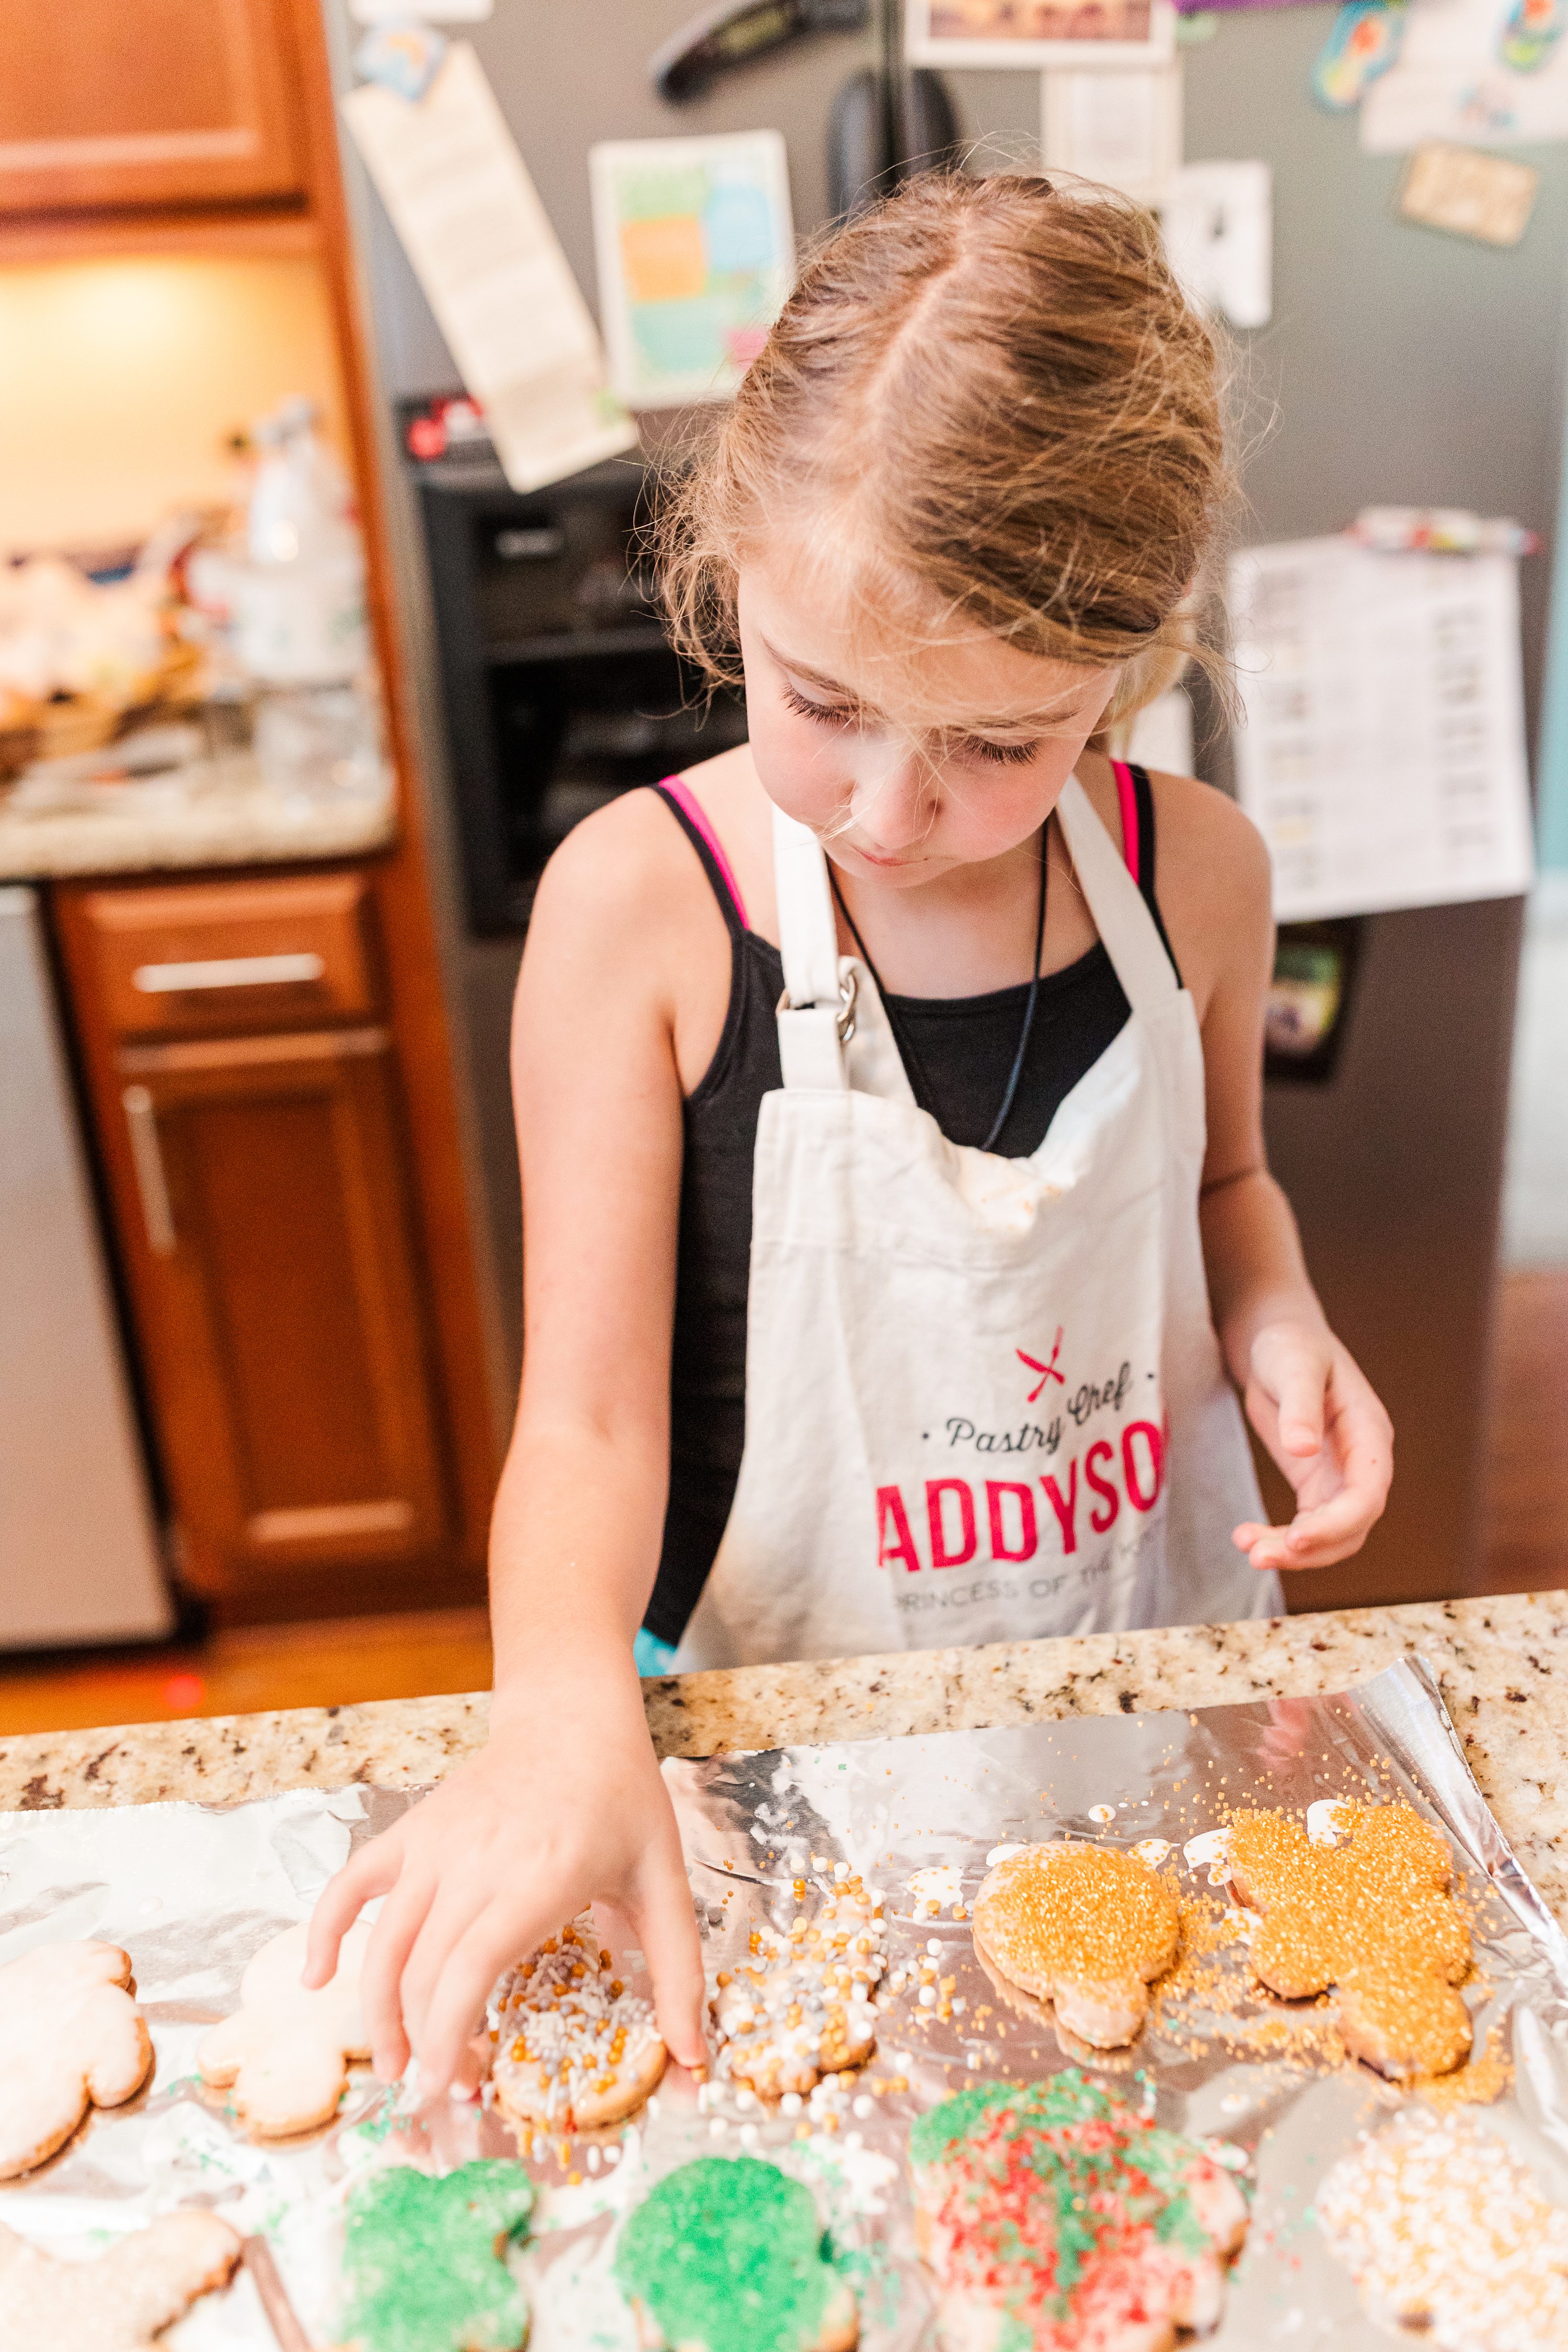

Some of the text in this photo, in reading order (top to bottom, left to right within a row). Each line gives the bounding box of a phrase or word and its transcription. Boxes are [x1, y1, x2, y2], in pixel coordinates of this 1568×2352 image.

[946, 1361, 1133, 1456] Pastry Chef
[875, 1419, 1167, 1573] ADDYSO
[1029, 1574, 1068, 1599] OF
